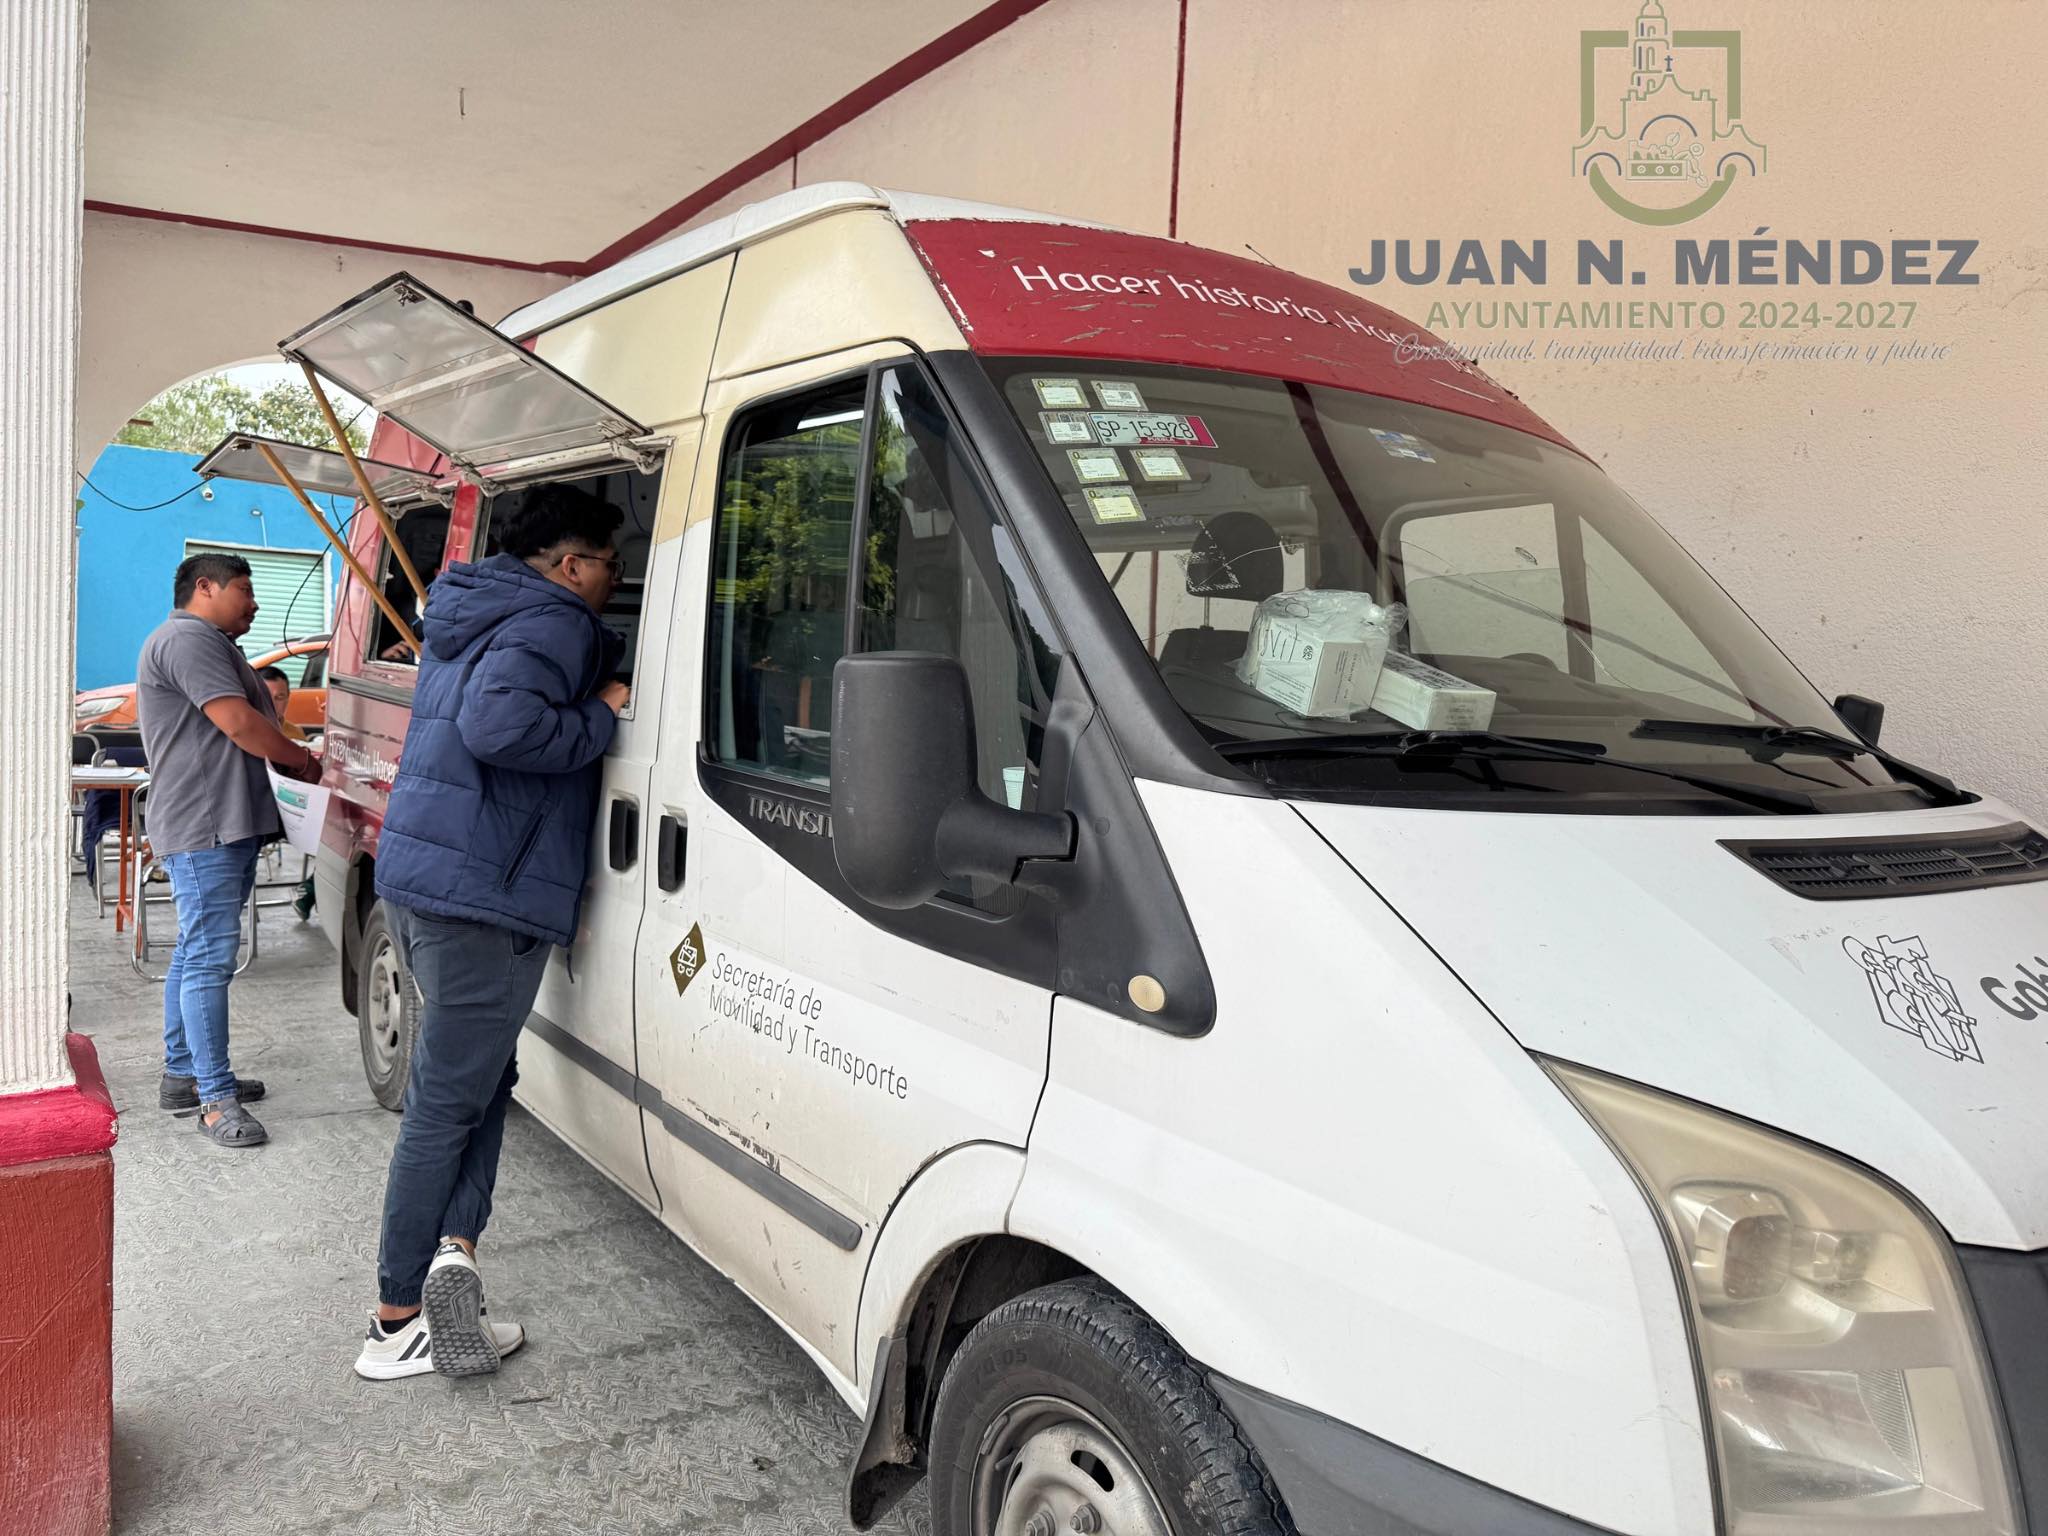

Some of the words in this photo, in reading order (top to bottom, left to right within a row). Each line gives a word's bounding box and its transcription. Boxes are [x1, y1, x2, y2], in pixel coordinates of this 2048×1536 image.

[1013, 265, 1161, 297] Hacer
[1096, 420, 1194, 439] SP-15-928
[750, 797, 833, 838] TRANSIT
[712, 952, 796, 1010] Secretaría
[799, 987, 822, 1020] de
[709, 984, 785, 1042] Movilidad
[787, 1025, 798, 1054] y
[804, 1024, 908, 1100] Transporte
